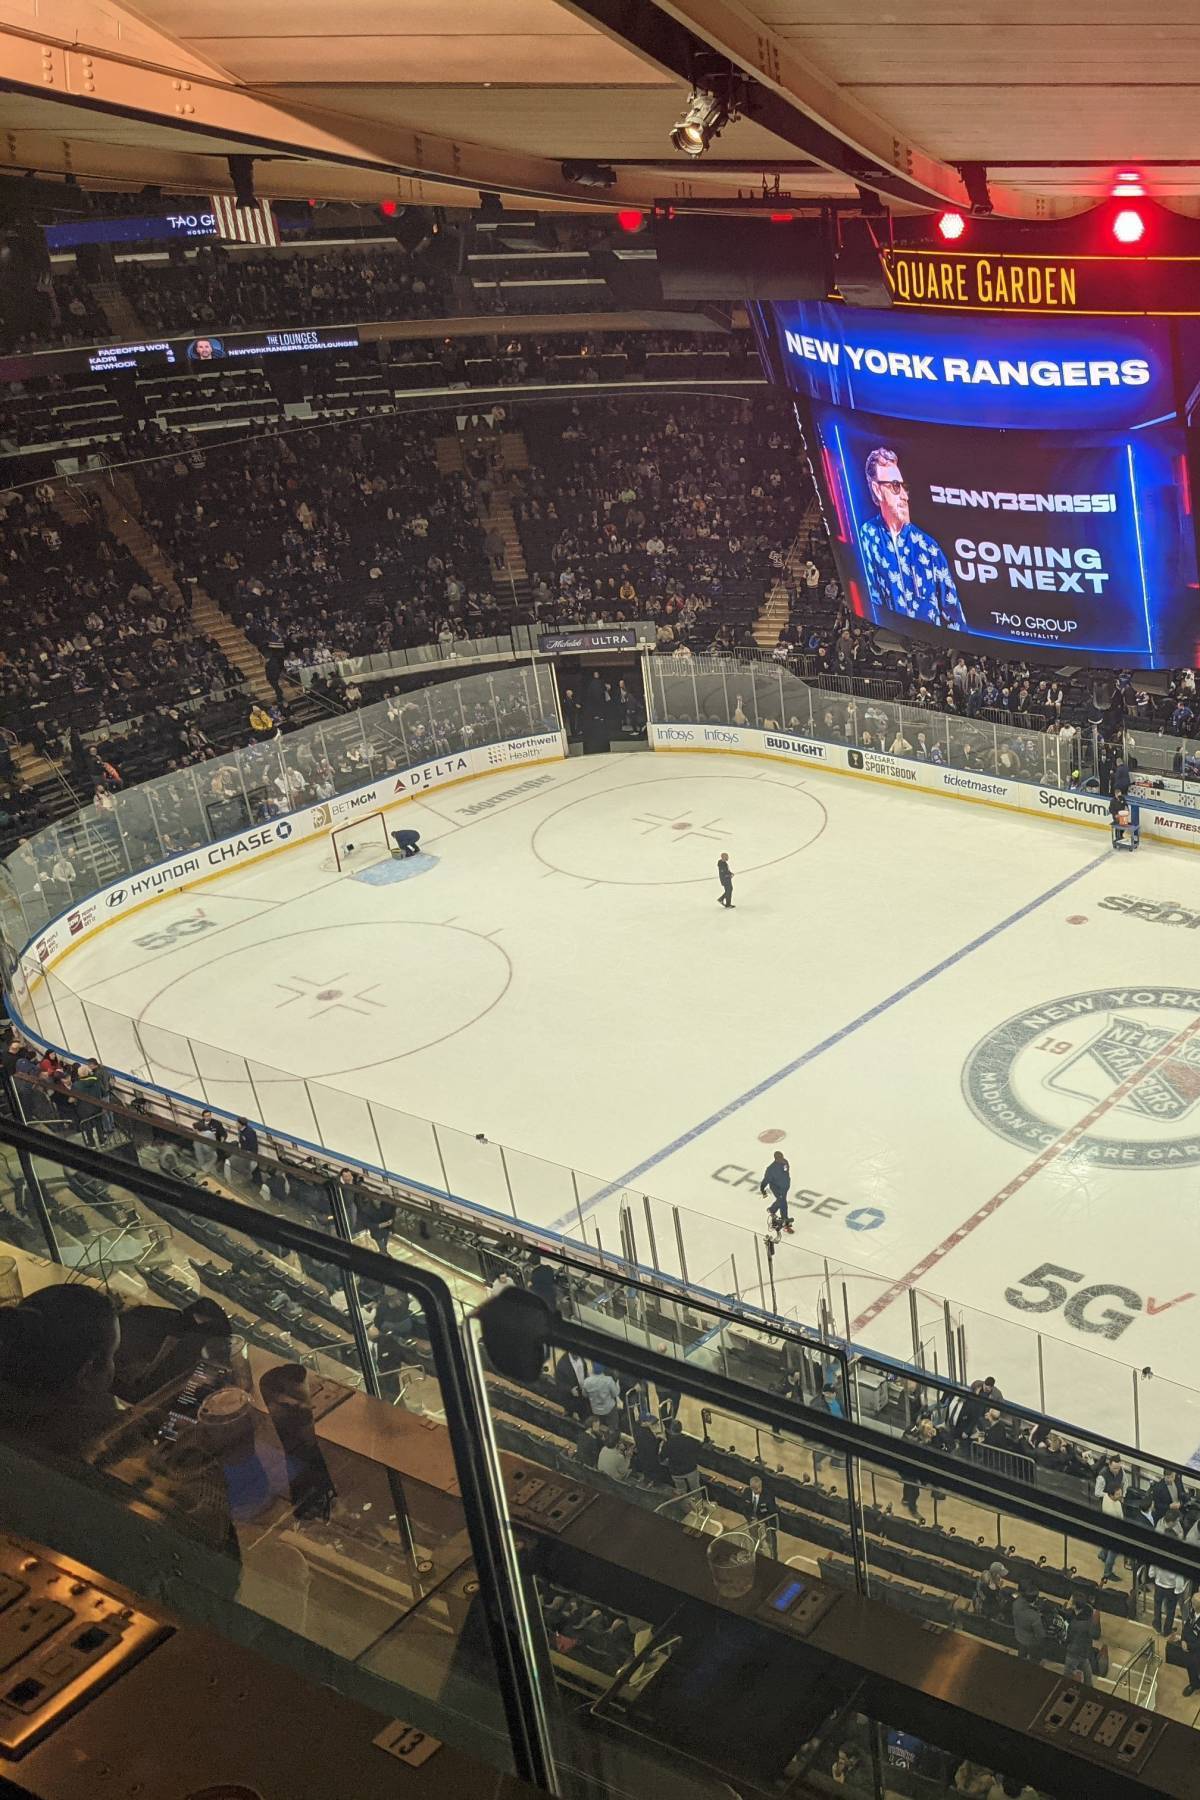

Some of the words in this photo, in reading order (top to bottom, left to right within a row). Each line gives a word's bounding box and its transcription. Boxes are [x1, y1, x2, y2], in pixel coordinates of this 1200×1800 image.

[166, 214, 197, 229] TAO
[977, 259, 1076, 305] GARDEN
[98, 345, 145, 357] FACEOFFS
[145, 342, 170, 352] WON
[228, 340, 359, 356] NEWYORKRANGERS.COM/LOUNGES
[266, 335, 279, 346] THE
[278, 332, 318, 346] LOUNGES
[89, 355, 117, 365] KADRI
[90, 360, 137, 372] NEWHOOK
[784, 329, 839, 366] NEW
[844, 345, 938, 381] YORK
[943, 356, 1150, 387] RANGERS
[954, 538, 1103, 570] COMING
[954, 560, 998, 584] UP
[1008, 567, 1109, 594] NEXT
[991, 611, 1022, 628] TAO
[1025, 616, 1078, 633] GROUP
[592, 635, 628, 646] ULTRA
[1010, 629, 1060, 641] HOSPITALITY
[508, 735, 558, 751] Northwell
[657, 728, 694, 742] Infosys
[704, 729, 740, 744] Infosys
[509, 748, 540, 761] Health
[766, 737, 791, 751] BUD
[791, 741, 824, 758] LIGHT
[864, 753, 895, 765] CAESARS
[410, 758, 468, 786] DELTA
[865, 761, 917, 781] SPORTSBOOK
[943, 774, 1008, 796] ticketmaster
[1039, 790, 1107, 817] Spectrum
[208, 829, 274, 866] CHASE
[131, 858, 200, 896] HYUNDAI
[1023, 997, 1097, 1029] NEW
[1034, 1036, 1073, 1056] 19
[1107, 1023, 1167, 1049] NEW
[1103, 1047, 1178, 1113] RANERS
[980, 1072, 1028, 1129] MADISON
[1026, 1128, 1137, 1160] SQARE
[711, 1164, 849, 1218] CHSE
[1004, 1262, 1143, 1341] 5G
[389, 1727, 425, 1755] 13
